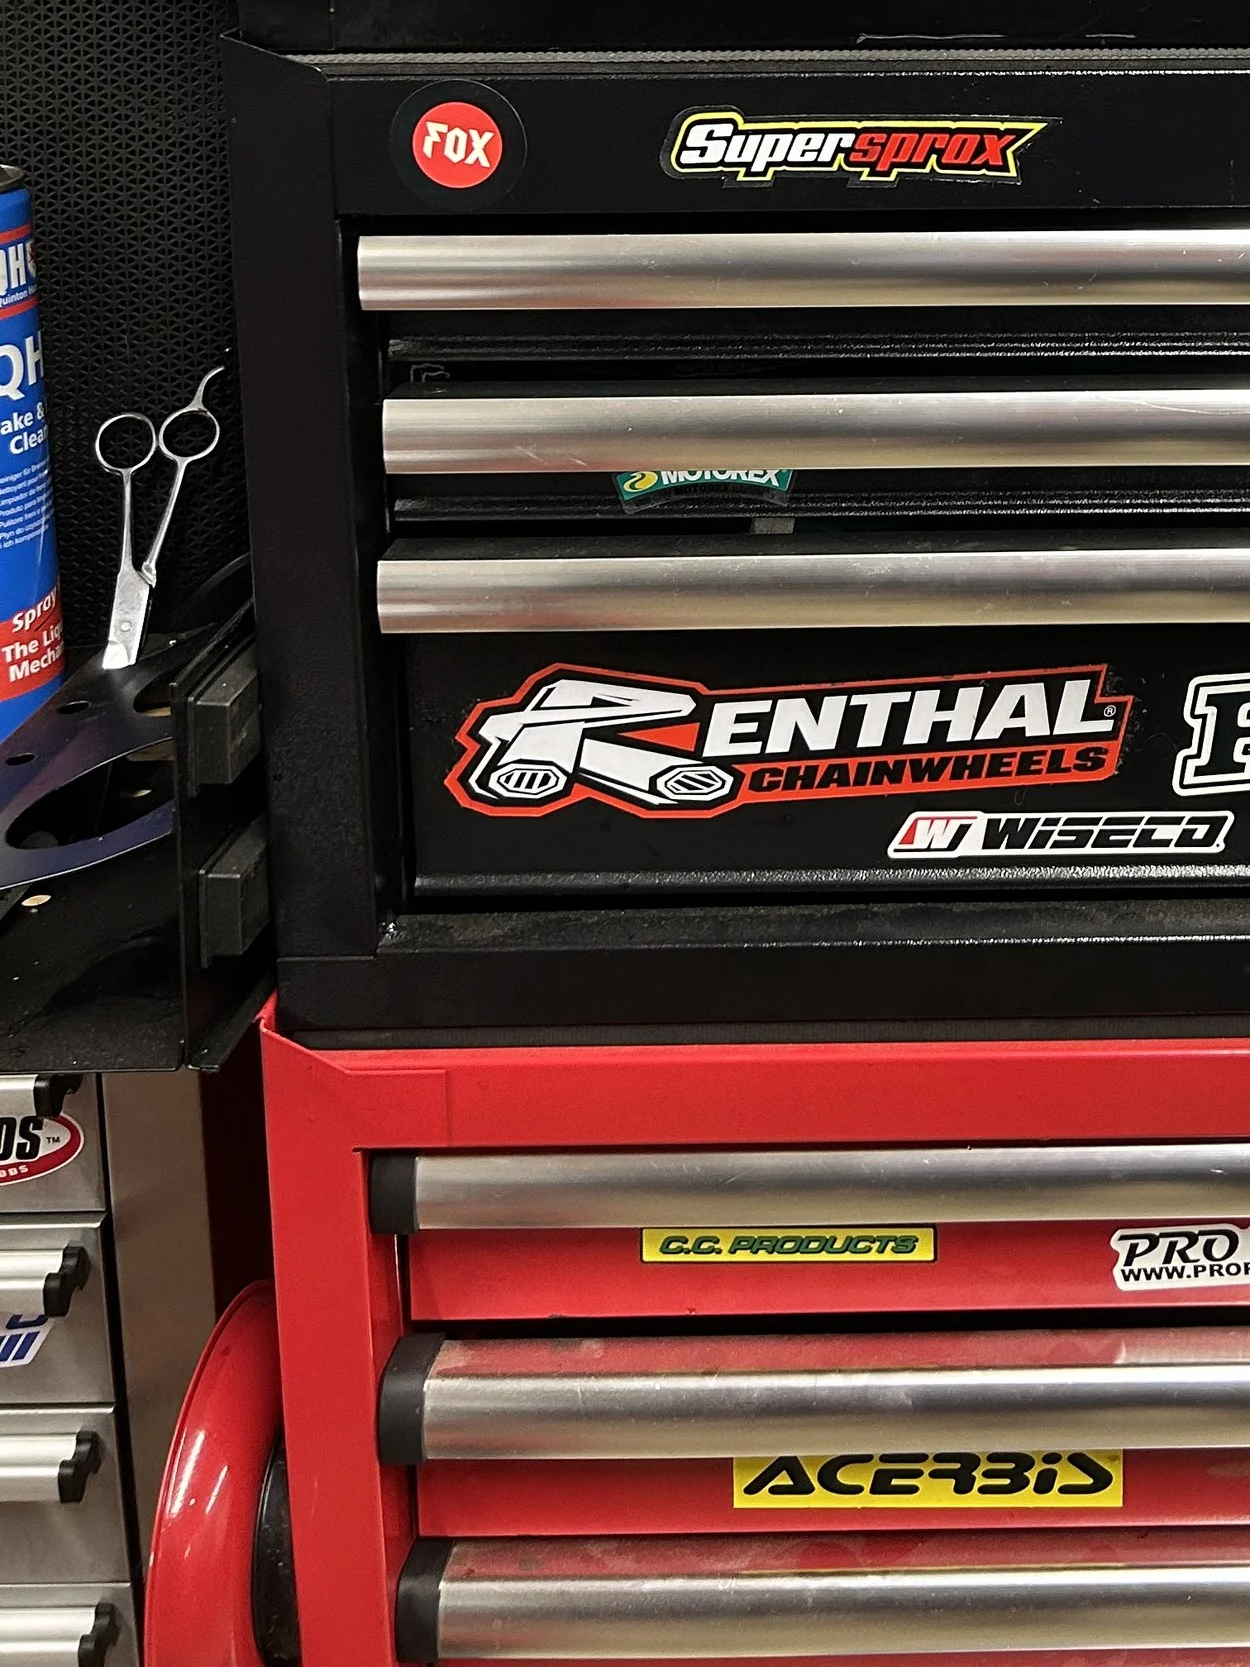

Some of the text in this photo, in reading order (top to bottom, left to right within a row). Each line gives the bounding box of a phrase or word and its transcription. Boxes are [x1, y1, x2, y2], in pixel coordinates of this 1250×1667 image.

[423, 121, 495, 170] FOX
[0, 289, 28, 308] uinton
[36, 401, 45, 421] &
[12, 586, 57, 633] Spray
[1, 638, 39, 663] The
[471, 678, 1119, 805] RENTHAL
[745, 746, 1111, 794] CHAINWHEELS
[658, 1234, 919, 1255] C.C. PRODUCTS
[1124, 1228, 1240, 1267] PRO
[743, 1451, 1115, 1496] ACERBIS
